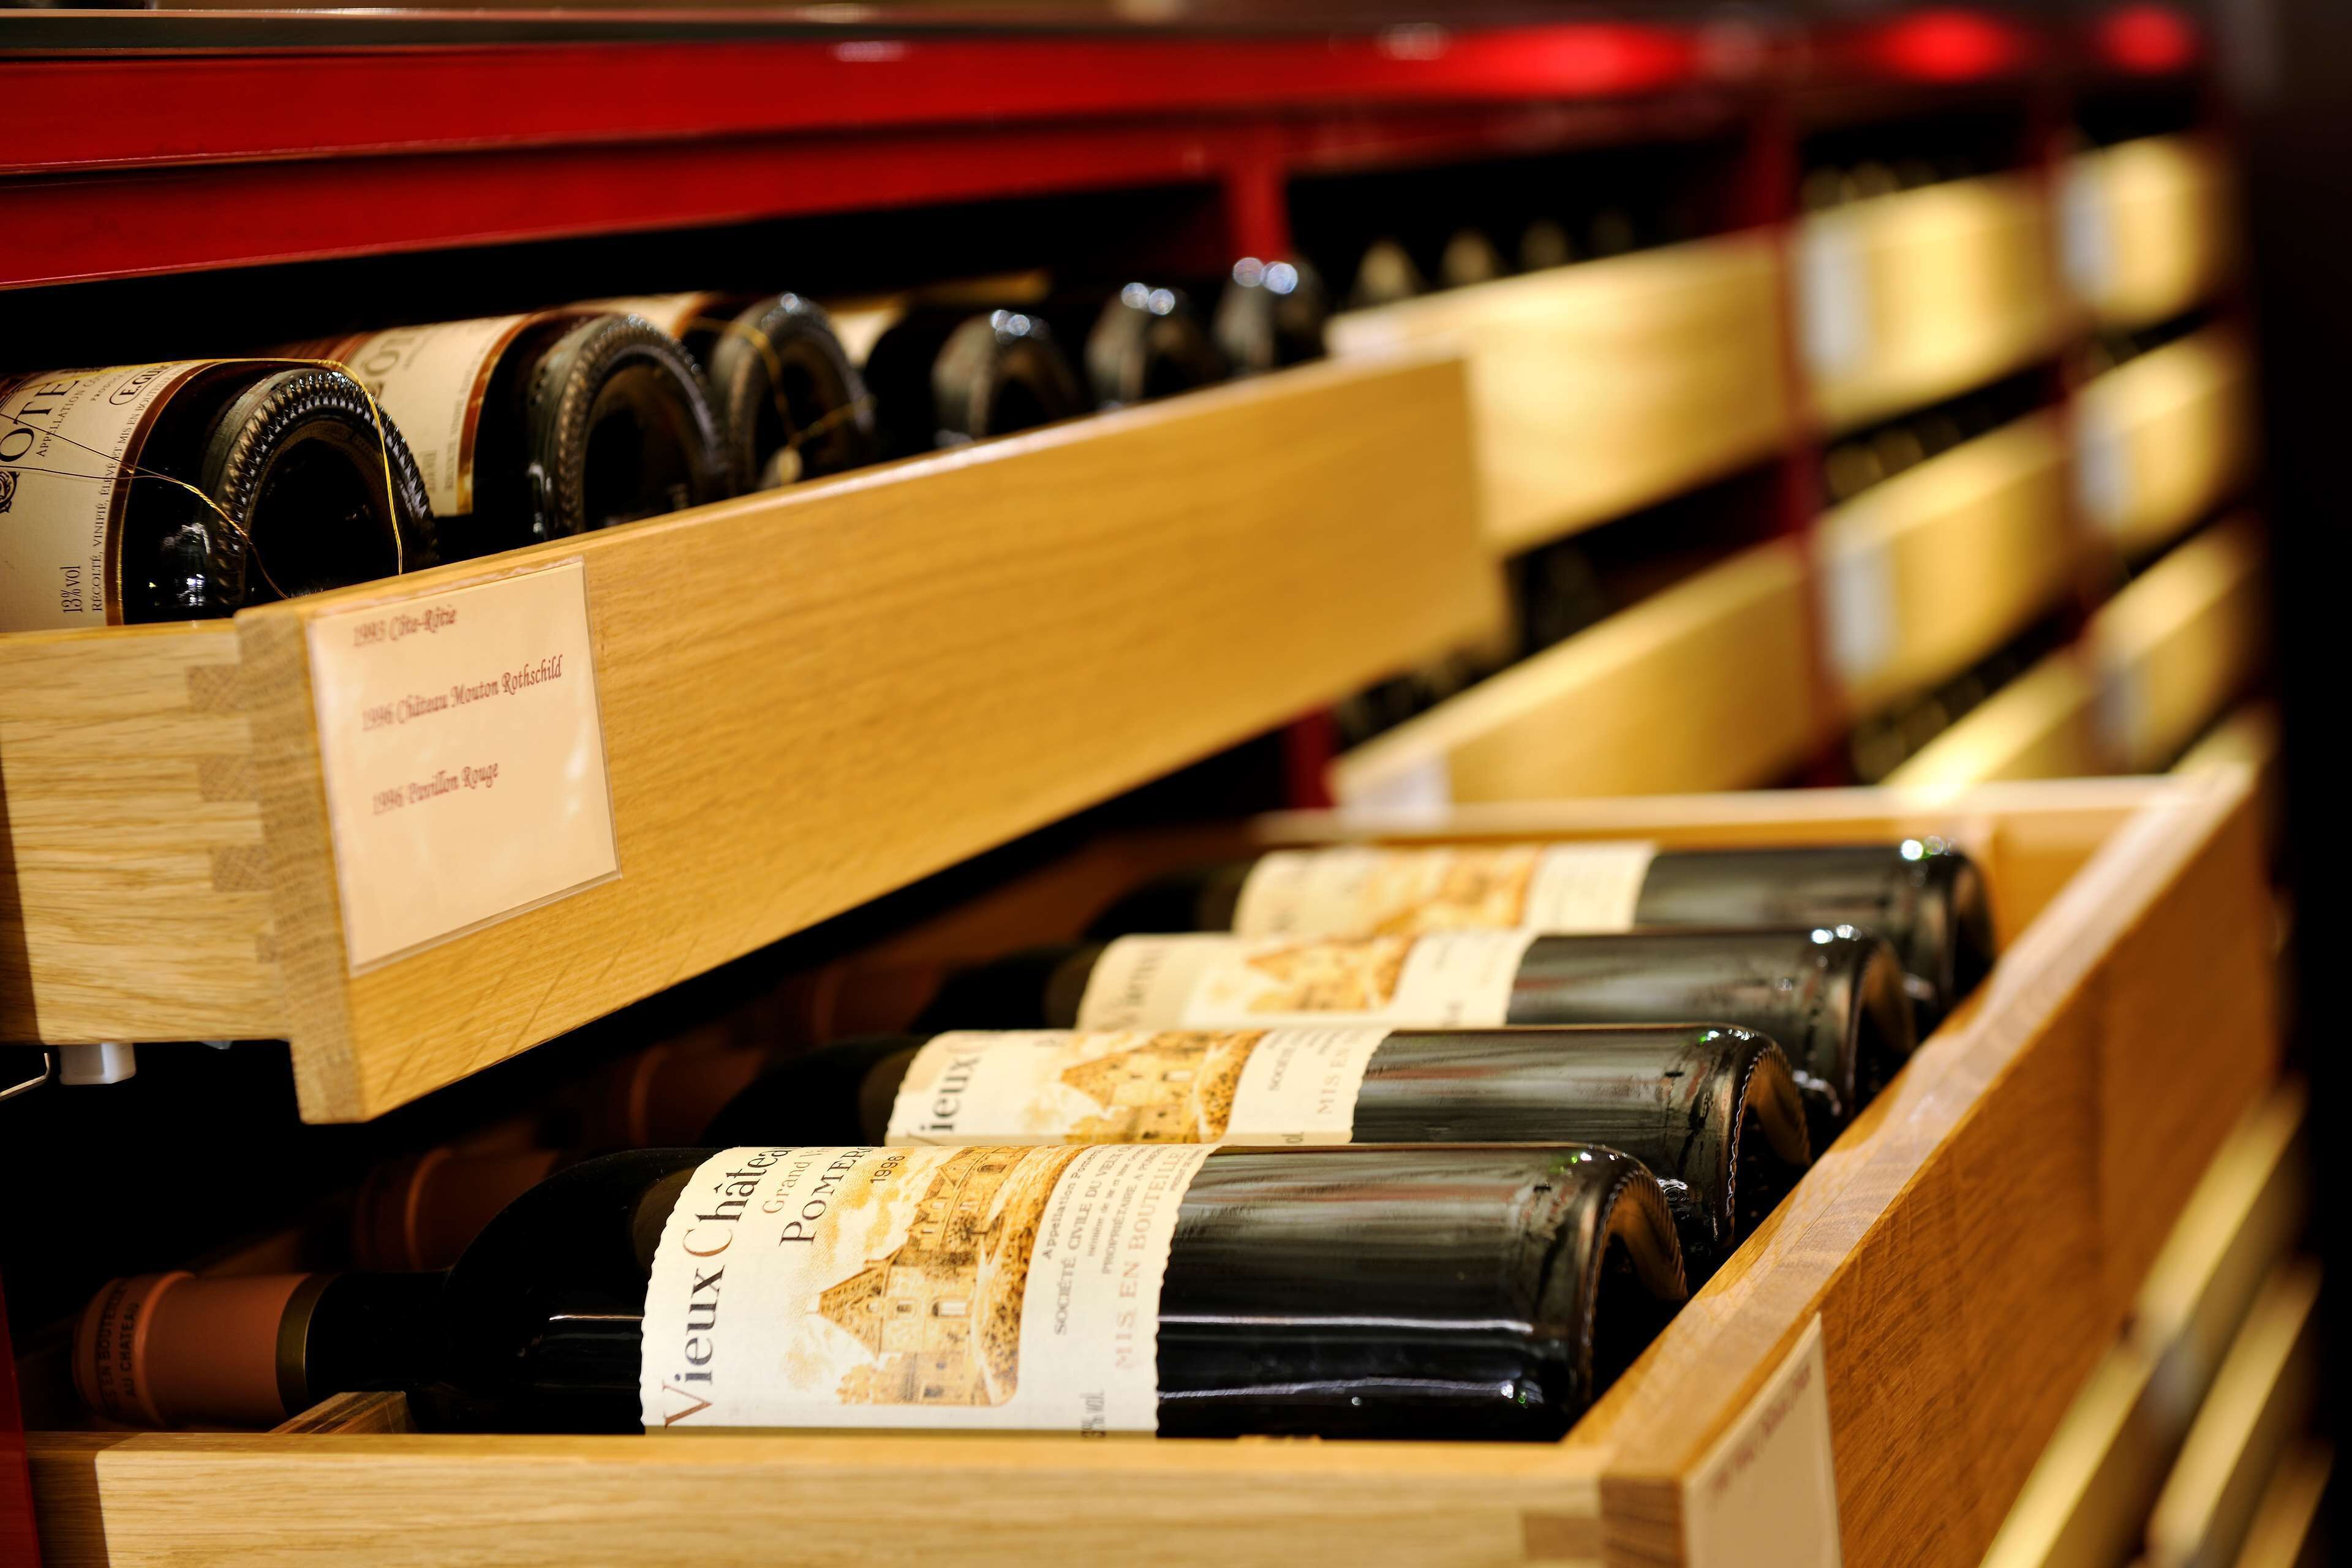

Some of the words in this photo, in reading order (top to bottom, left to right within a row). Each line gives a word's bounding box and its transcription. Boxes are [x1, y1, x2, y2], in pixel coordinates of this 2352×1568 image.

[35, 382, 86, 458] APPELLATION
[117, 428, 132, 444] MIS
[127, 413, 140, 425] EN
[59, 565, 81, 587] vol
[60, 589, 83, 613] 13%
[388, 603, 457, 641] Côte-Rôtie
[362, 703, 394, 732] 1996
[396, 694, 448, 725] Château
[450, 680, 499, 708] Mouton
[500, 653, 564, 696] Rothschild
[372, 786, 405, 816] 1996
[407, 769, 459, 805] Pavillon
[461, 763, 499, 790] Rouge
[762, 1160, 814, 1215] Grand
[1127, 1151, 1184, 1252] BOUTEILLE
[1041, 1181, 1077, 1261] Appellation
[1054, 1255, 1077, 1336] SOCIÉTÉ
[1068, 1202, 1093, 1251] CIVILE
[1085, 1180, 1102, 1199] DU
[1099, 1152, 1121, 1178] VIEUX
[1101, 1183, 1137, 1275] PROPRIÉTAIRE
[1118, 1260, 1142, 1299] EN
[662, 1264, 726, 1431] Vieux
[1115, 1308, 1137, 1370] MIS
